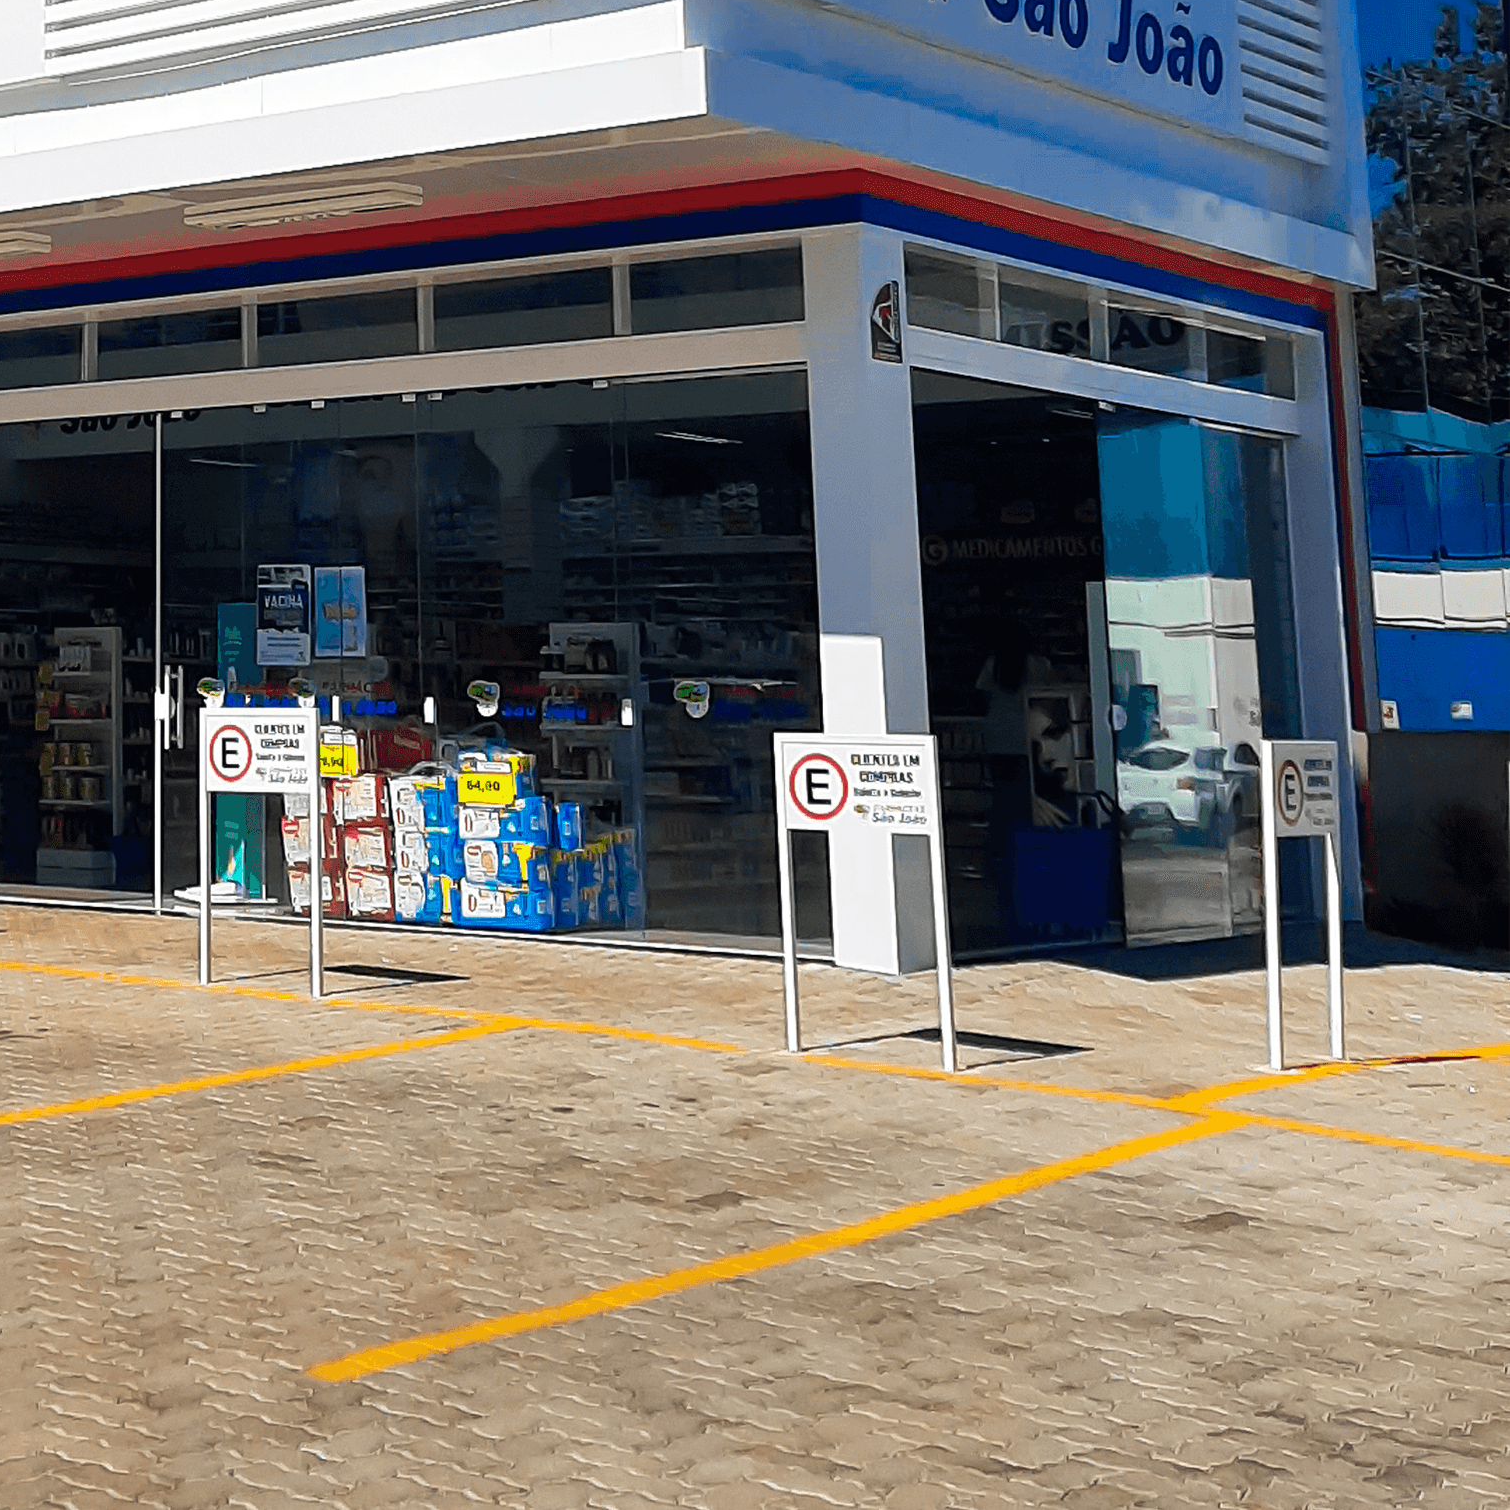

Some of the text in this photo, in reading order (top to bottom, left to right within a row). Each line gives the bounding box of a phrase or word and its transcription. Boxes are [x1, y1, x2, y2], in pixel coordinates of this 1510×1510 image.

[221, 737, 240, 769] E
[806, 768, 832, 805] E
[1284, 774, 1297, 811] E
